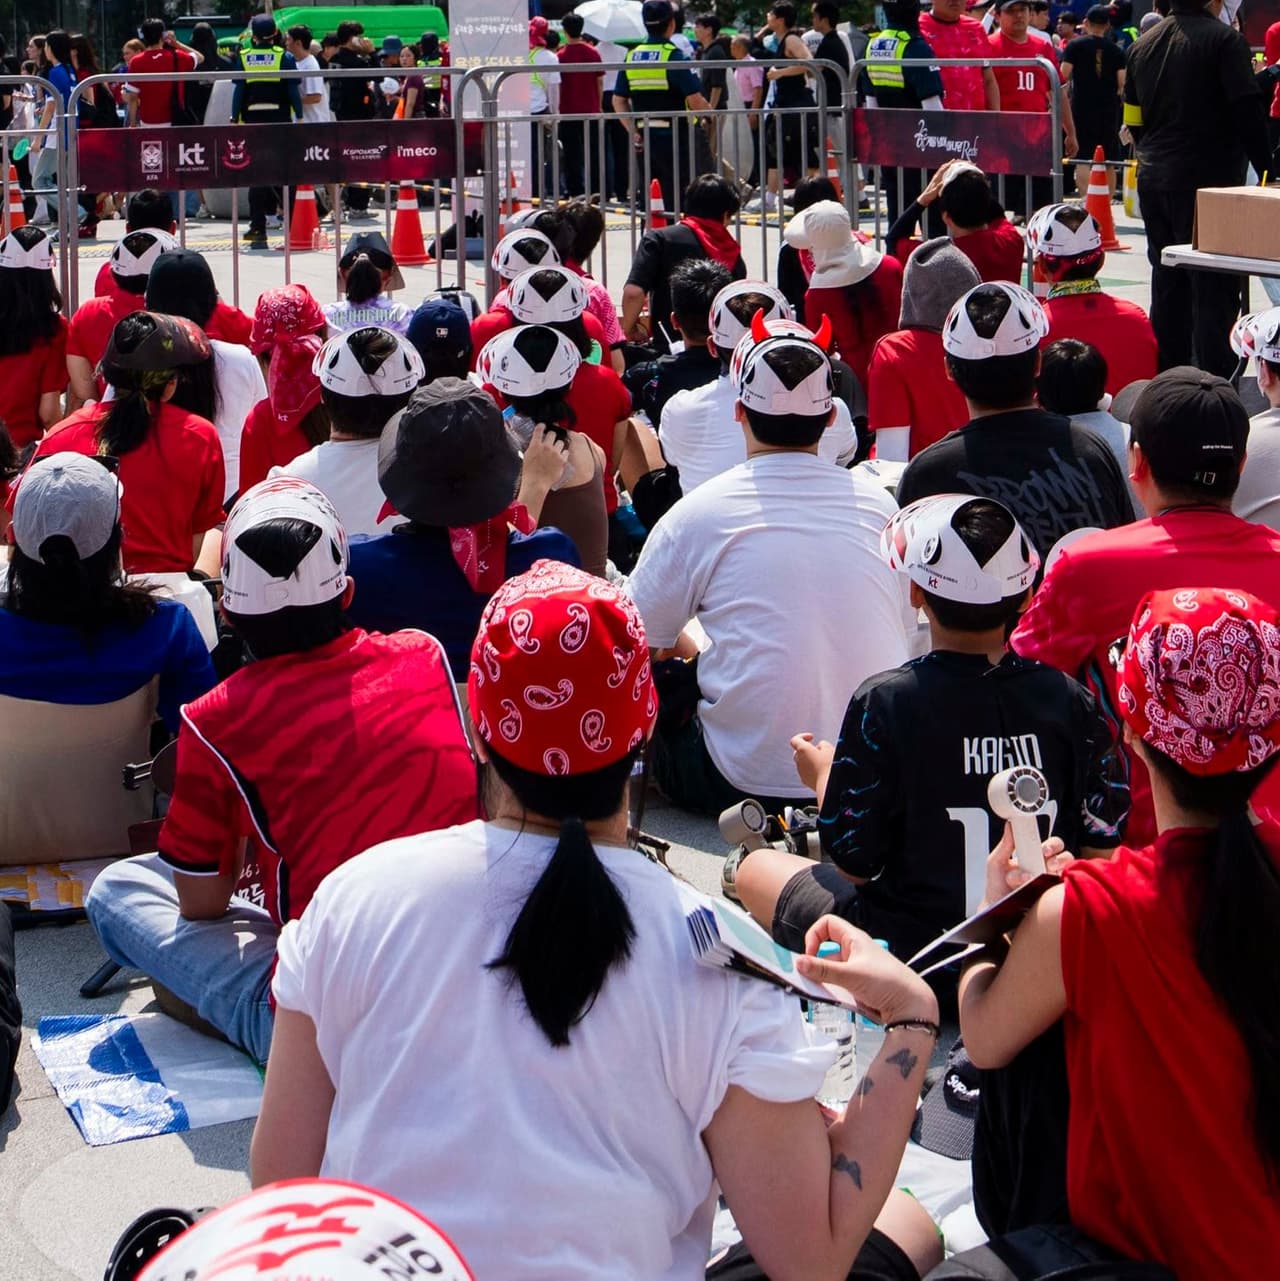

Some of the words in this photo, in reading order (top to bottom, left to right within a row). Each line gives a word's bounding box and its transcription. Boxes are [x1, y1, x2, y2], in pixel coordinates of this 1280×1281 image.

[1017, 71, 1035, 91] 10
[179, 143, 206, 166] kt
[928, 575, 939, 589] kt
